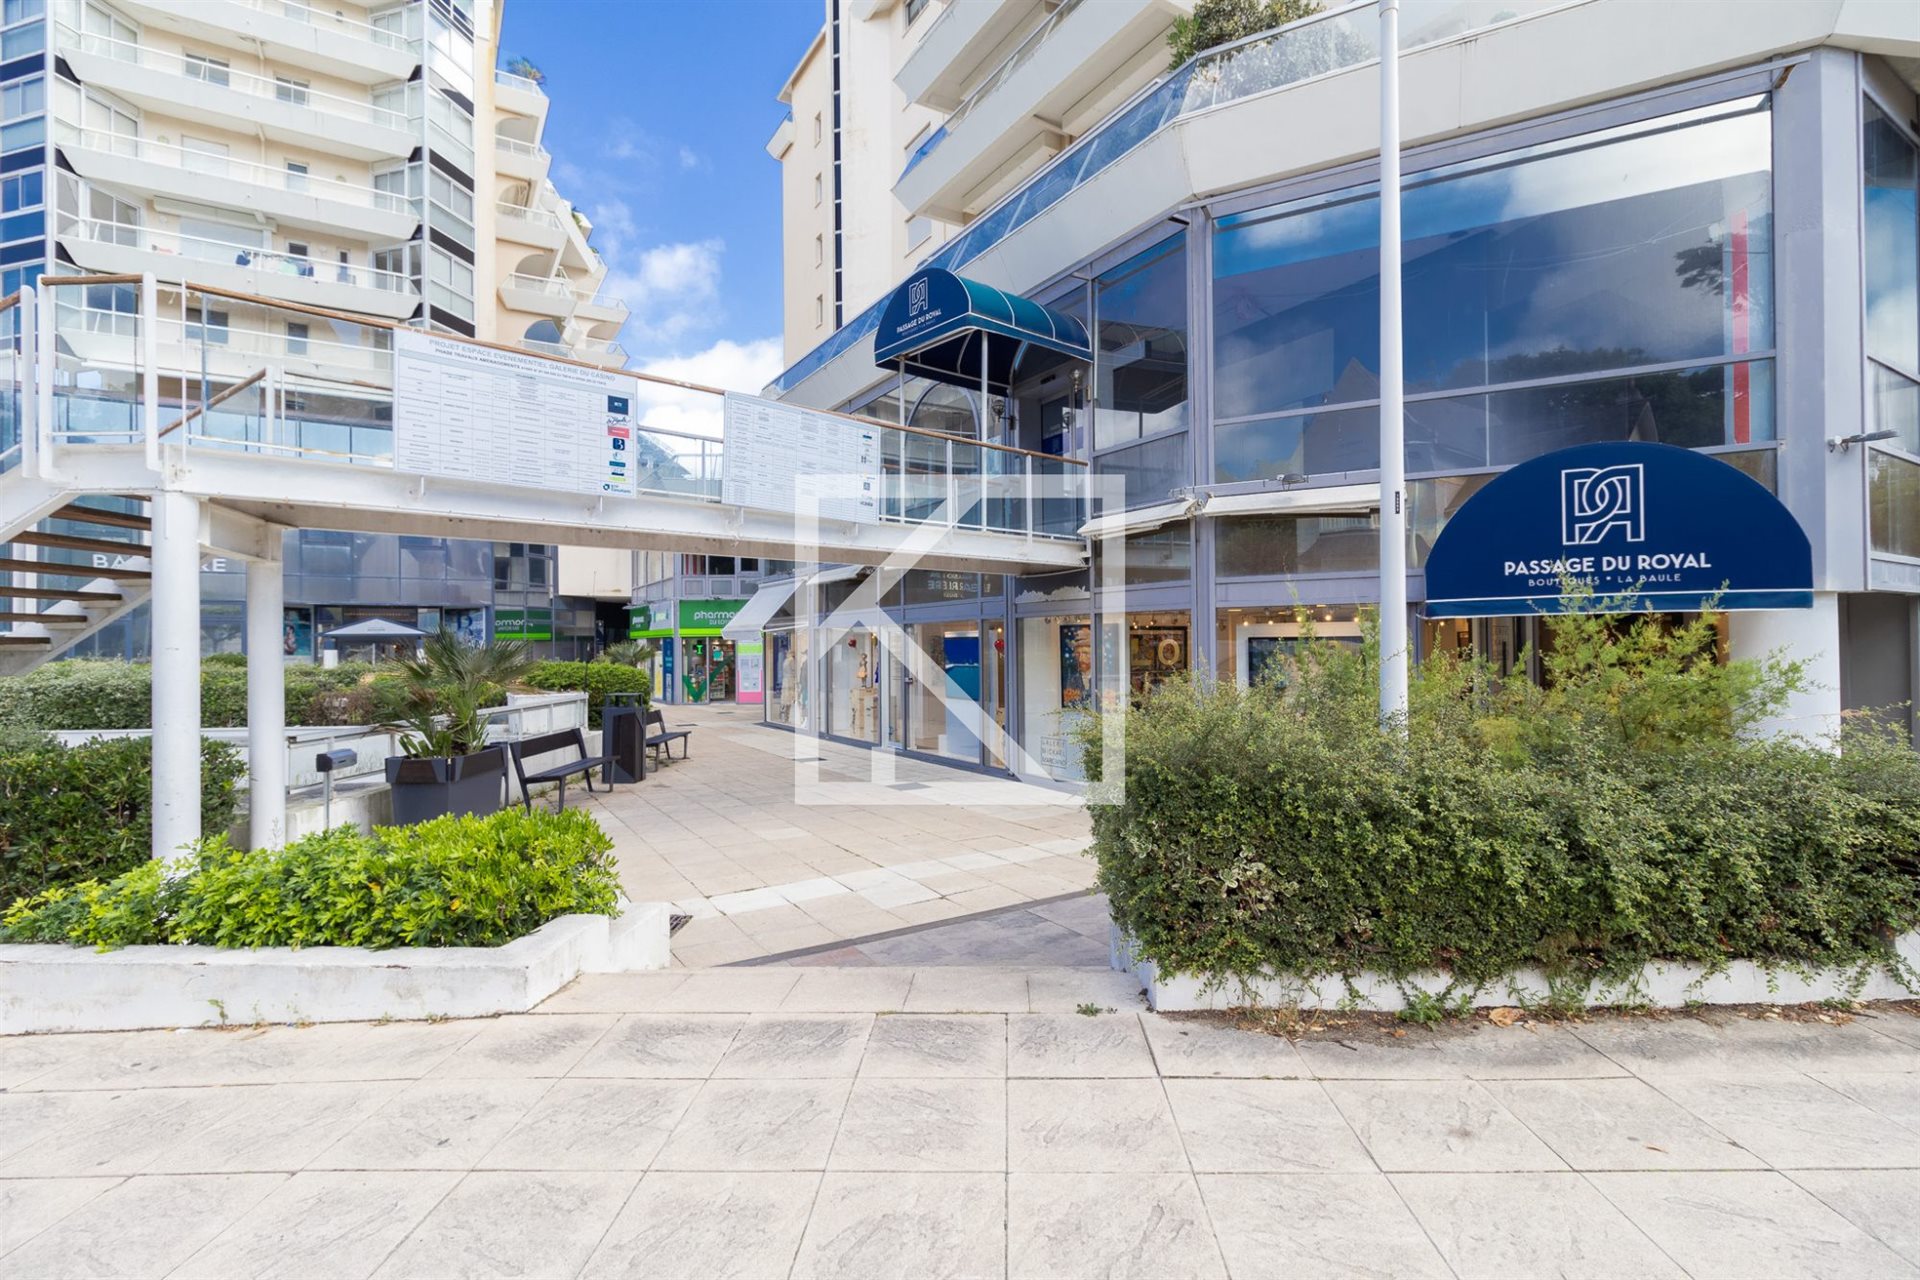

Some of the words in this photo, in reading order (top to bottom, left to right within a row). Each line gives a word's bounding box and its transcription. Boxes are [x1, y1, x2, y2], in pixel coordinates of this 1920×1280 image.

[896, 318, 918, 334] PASSAGE
[918, 315, 926, 324] DU
[926, 308, 942, 320] ROYAL
[429, 339, 460, 351] PROJET
[462, 346, 492, 358] ESPACE
[549, 363, 578, 374] GALERIE
[590, 370, 616, 381] CASINO
[1504, 557, 1595, 576] PASSAGE
[1602, 556, 1631, 572] DU
[1637, 552, 1712, 570] ROYAL
[1617, 575, 1633, 583] LA
[1639, 573, 1681, 582] BAULE
[694, 611, 739, 620] pharma
